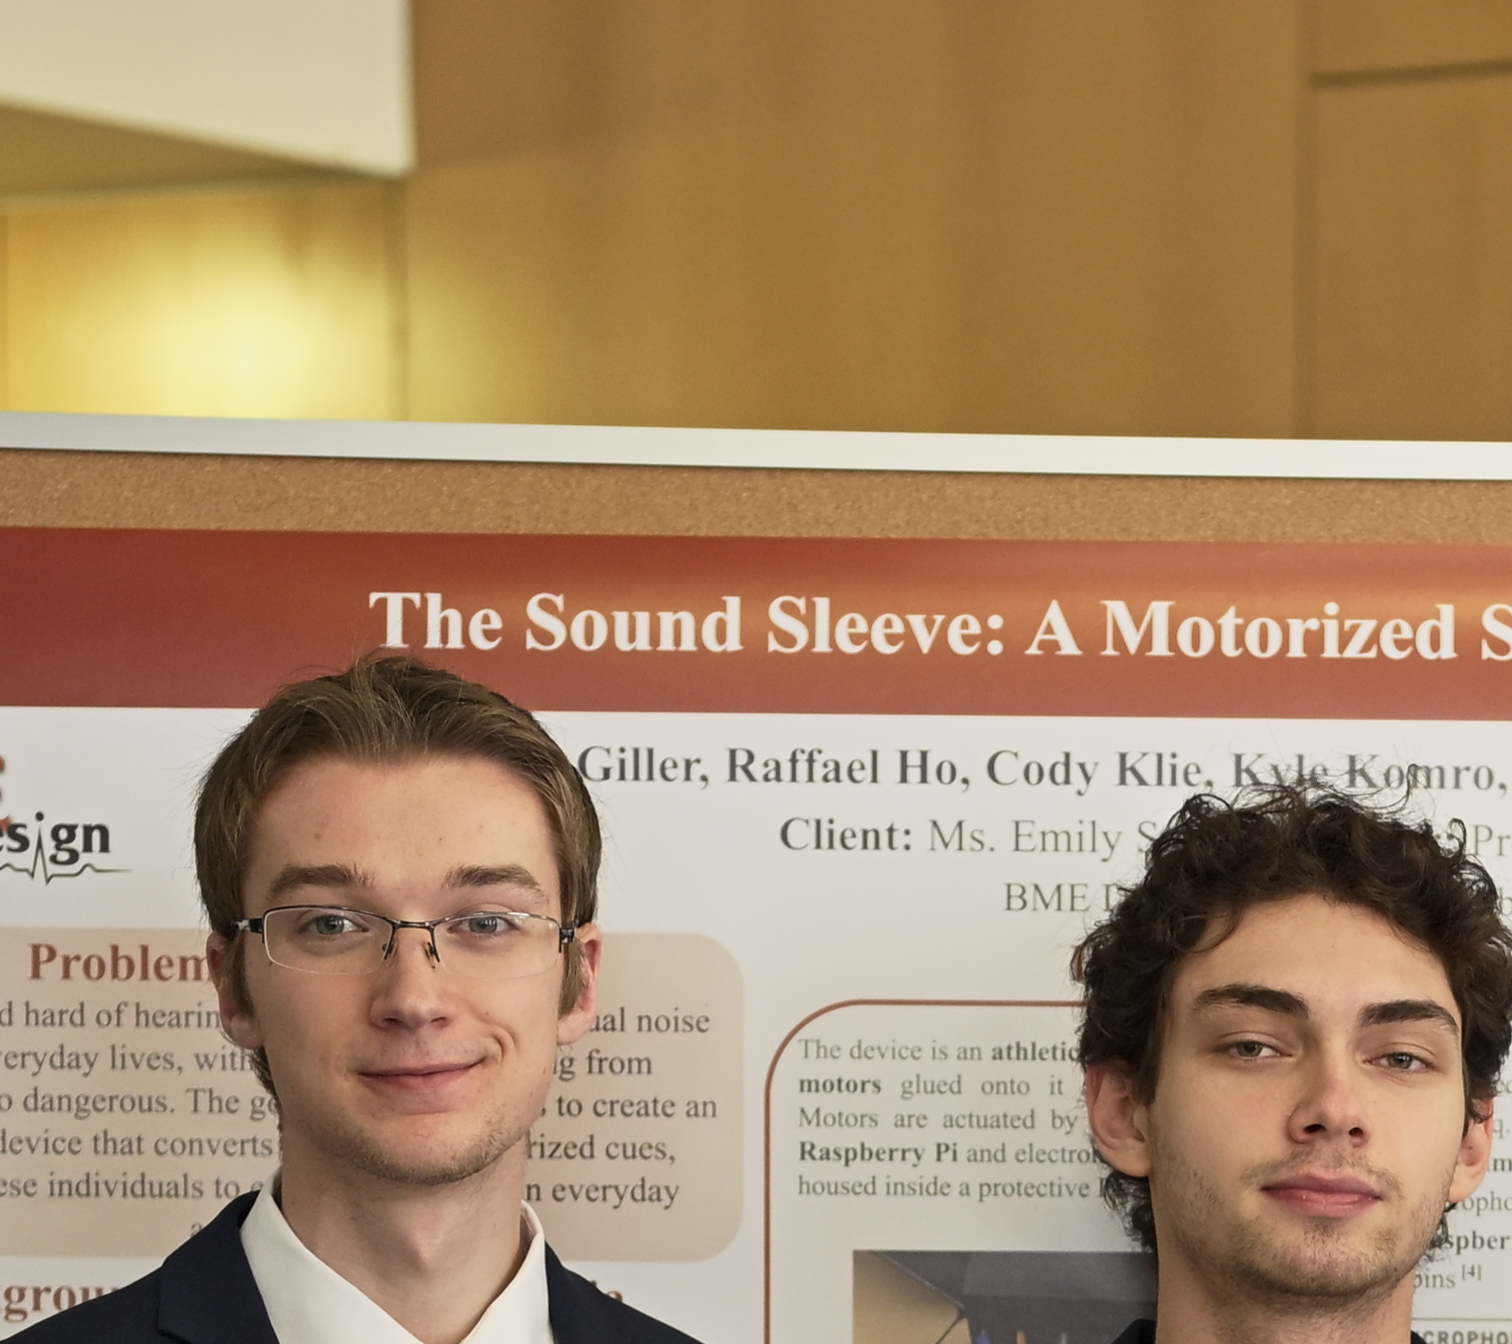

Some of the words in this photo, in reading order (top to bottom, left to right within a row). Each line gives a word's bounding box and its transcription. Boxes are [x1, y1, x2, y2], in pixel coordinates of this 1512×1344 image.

[368, 591, 504, 651] The
[525, 591, 744, 653] Sound
[767, 594, 1005, 656] Sleeve:
[1023, 598, 1084, 656] A
[1099, 599, 1458, 661] Motorized
[578, 745, 710, 790] Giller,
[726, 747, 880, 785] Raffael
[897, 749, 971, 793] Ho,
[985, 749, 1099, 798] Cody
[1116, 751, 1215, 794] Klie,
[1232, 752, 1329, 799] Kyle
[1345, 753, 1508, 798] Komro,
[779, 816, 912, 852] Client:
[928, 818, 996, 853] Ms.
[1012, 819, 1123, 864] Emily
[1005, 882, 1090, 913] BME
[24, 1000, 86, 1029] hard
[636, 1014, 711, 1034] noise
[109, 1043, 184, 1075] lives,
[585, 1047, 653, 1076] from
[848, 1038, 923, 1062] device
[22, 1085, 176, 1121] dangerous.
[591, 1096, 676, 1119] create
[799, 1076, 882, 1094] motors
[900, 1073, 963, 1101] glued
[980, 1078, 1031, 1096] onto
[798, 1106, 880, 1129] Motors
[942, 1107, 1037, 1131] actuated
[92, 1128, 143, 1157] that
[153, 1135, 274, 1158] converts
[604, 1141, 676, 1165] cues,
[799, 1140, 923, 1169] Raspberry
[48, 1170, 204, 1200] individuals
[550, 1176, 680, 1211] everyday
[798, 1174, 878, 1197] housed
[885, 1174, 952, 1198] inside
[978, 1176, 1092, 1204] protective
